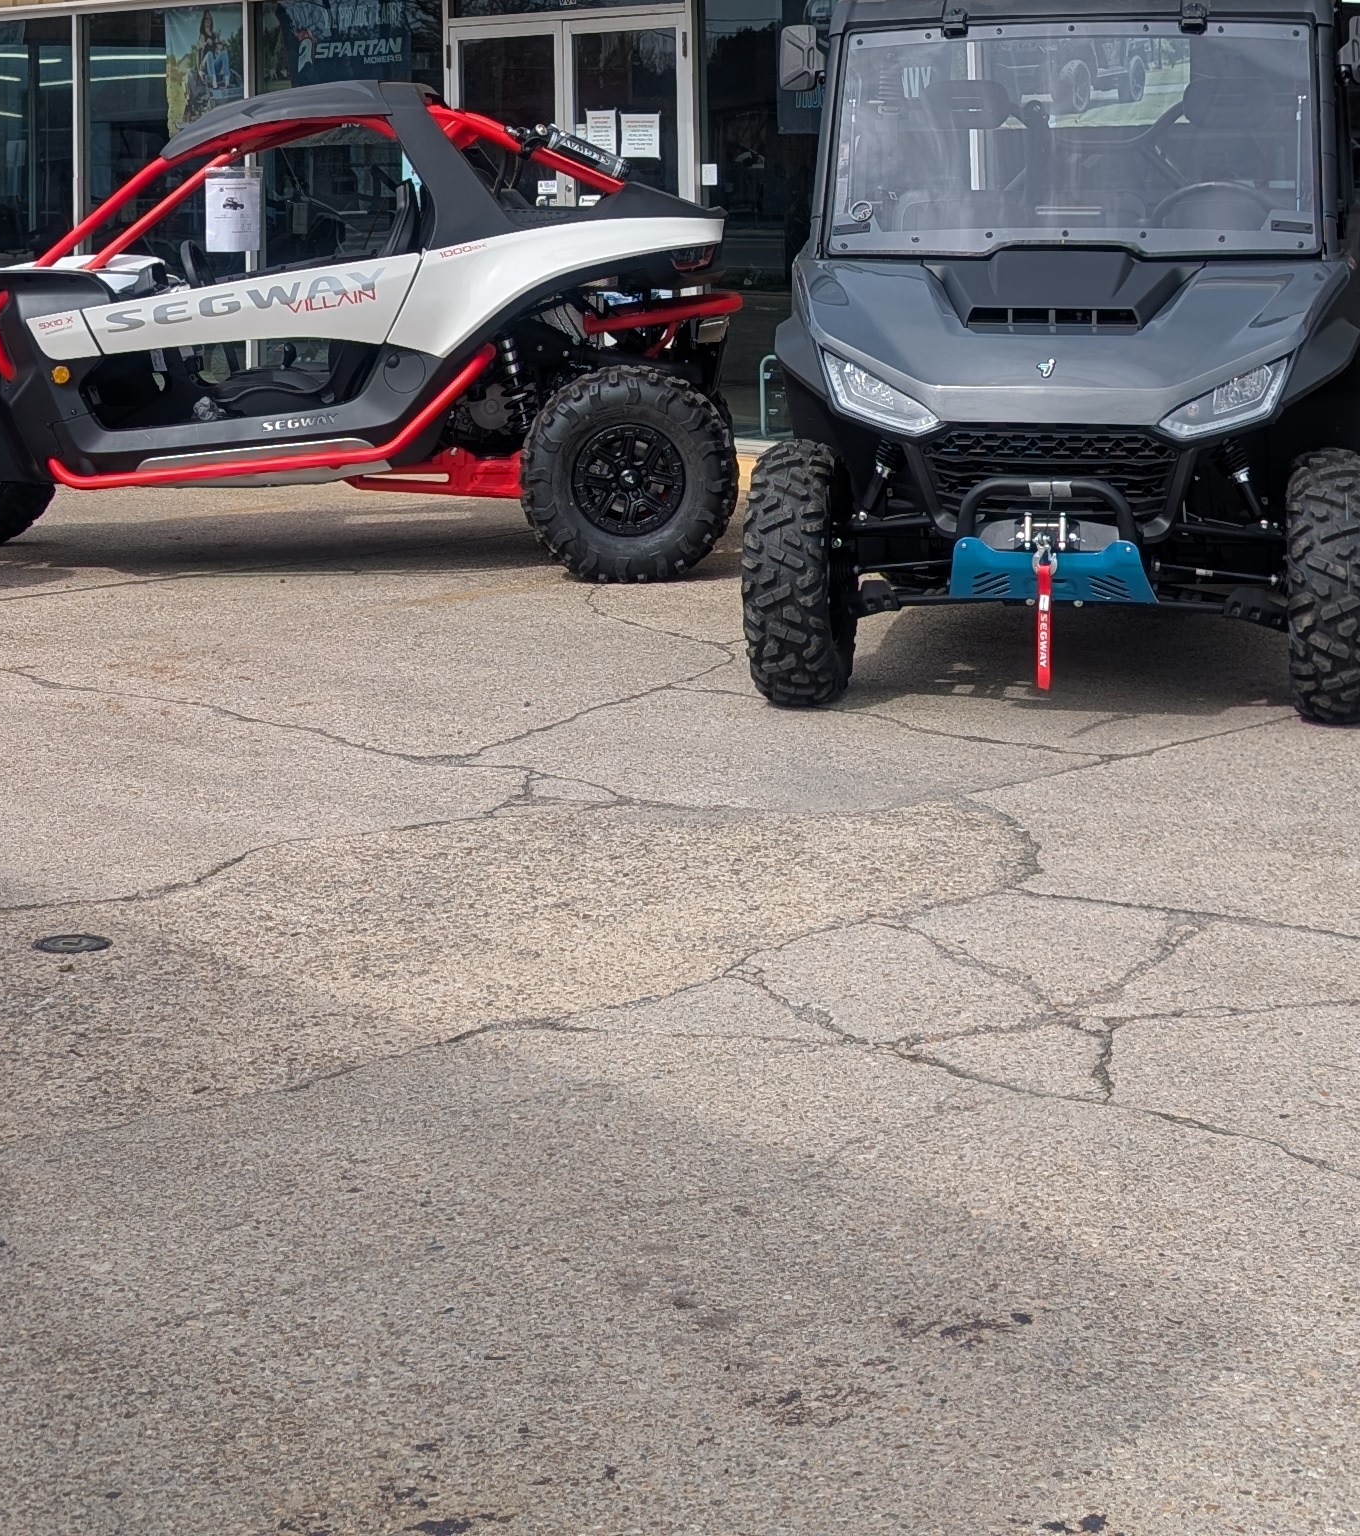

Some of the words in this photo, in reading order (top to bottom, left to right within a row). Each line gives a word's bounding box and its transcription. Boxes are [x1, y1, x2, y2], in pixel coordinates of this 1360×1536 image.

[314, 37, 403, 59] SPARTAN
[105, 267, 386, 333] SEGWAY
[284, 288, 377, 314] VILLAIN
[262, 413, 339, 432] SEGWAY
[1040, 613, 1048, 668] SEGWAY
